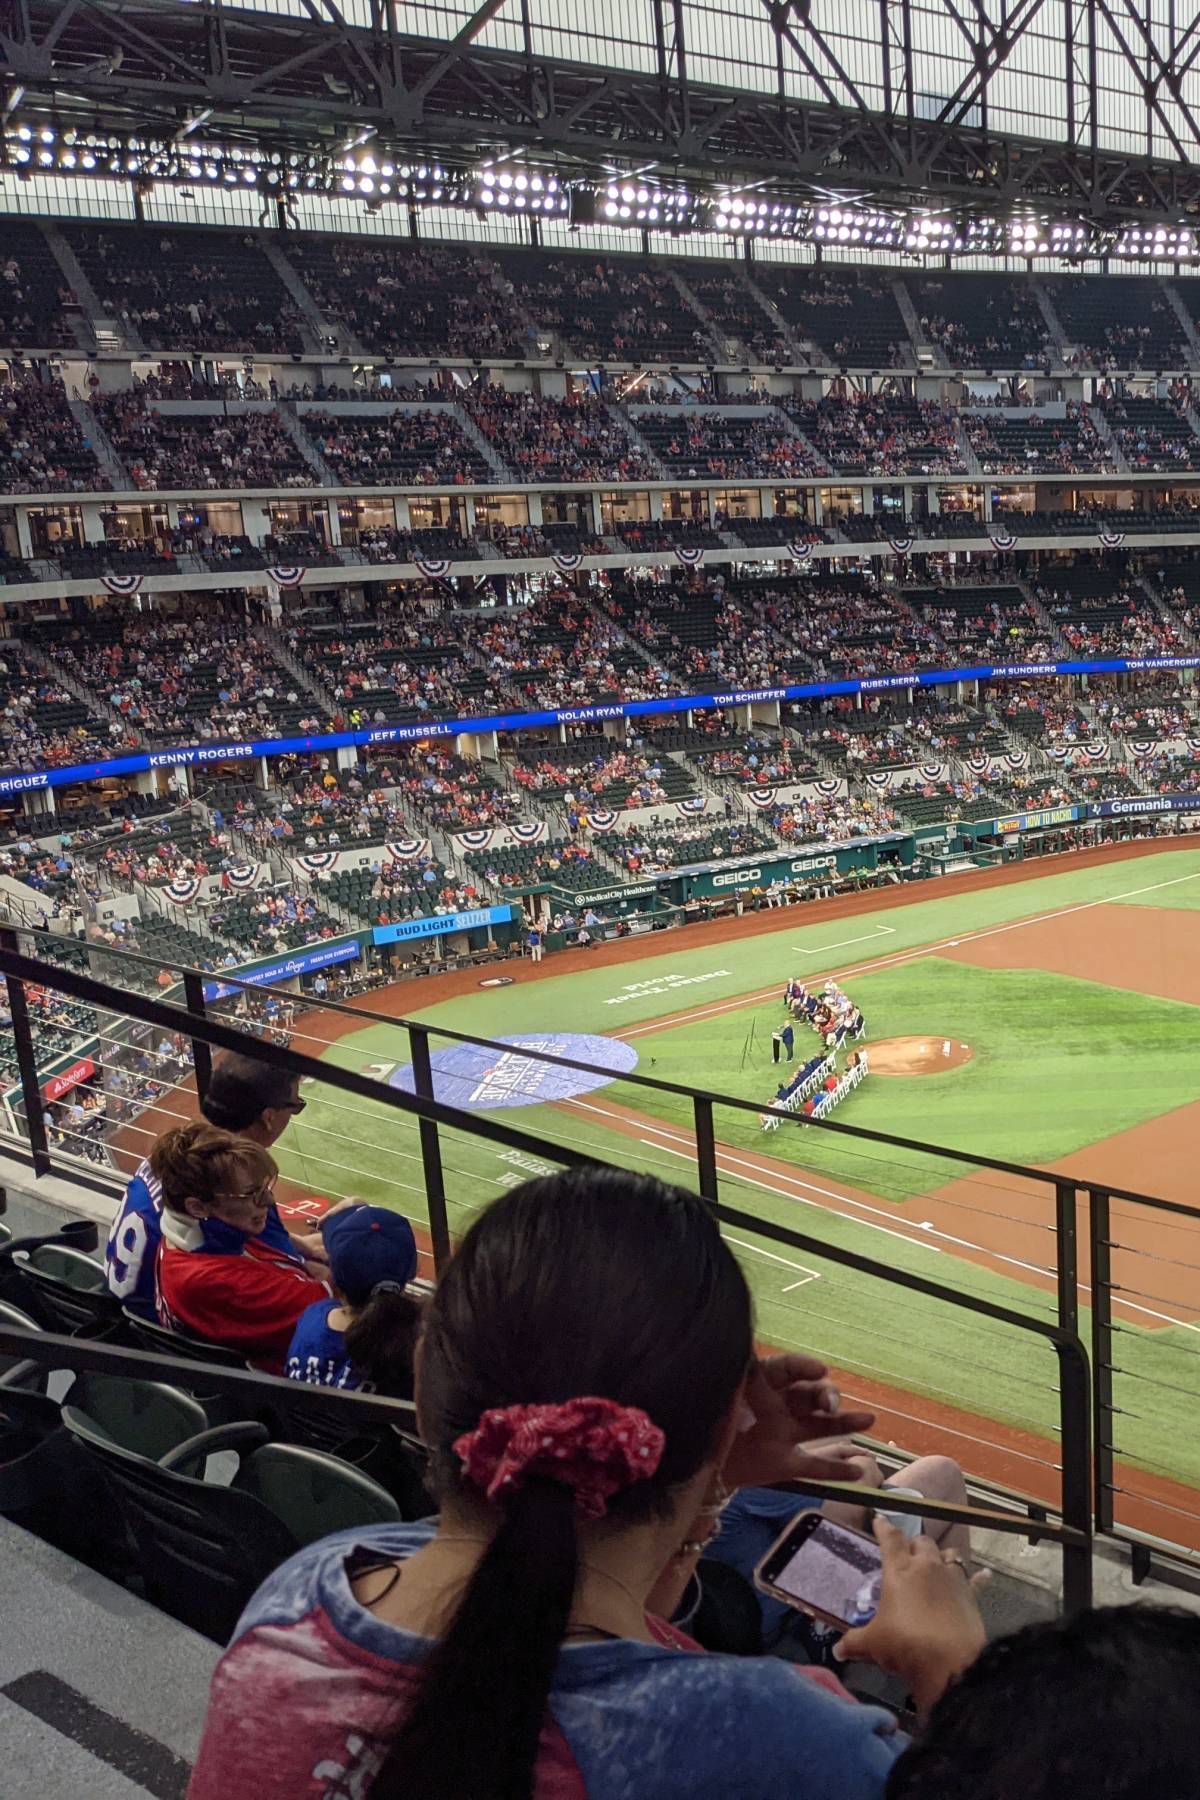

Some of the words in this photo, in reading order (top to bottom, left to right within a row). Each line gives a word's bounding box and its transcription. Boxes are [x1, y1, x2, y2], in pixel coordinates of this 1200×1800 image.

[991, 668, 1007, 676] JIM
[1008, 665, 1057, 676] SUNDBERG
[1126, 660, 1144, 669] TOM
[861, 680, 889, 689] RUBEN
[891, 676, 920, 687] SIERRA
[713, 695, 733, 704] TOM
[735, 690, 786, 702] SCHIEFFER
[557, 710, 594, 721] NOLAN
[597, 706, 624, 718] RYAN
[368, 730, 396, 742] JEFF
[400, 726, 452, 739] RUSSELL
[150, 751, 194, 767] KENNY
[199, 746, 253, 760] ROGERS
[1111, 798, 1172, 814] Germania
[1025, 814, 1041, 827] HOW
[1042, 813, 1050, 824] TO
[791, 855, 837, 873] GEICO
[712, 869, 762, 887] GEICO
[586, 892, 611, 903] Medical
[610, 891, 623, 899] City
[623, 885, 657, 896] Healthcare
[396, 924, 420, 937] BUD
[422, 918, 455, 933] LIGHT
[455, 910, 492, 929] SELTZER
[496, 1150, 559, 1177] Dallas
